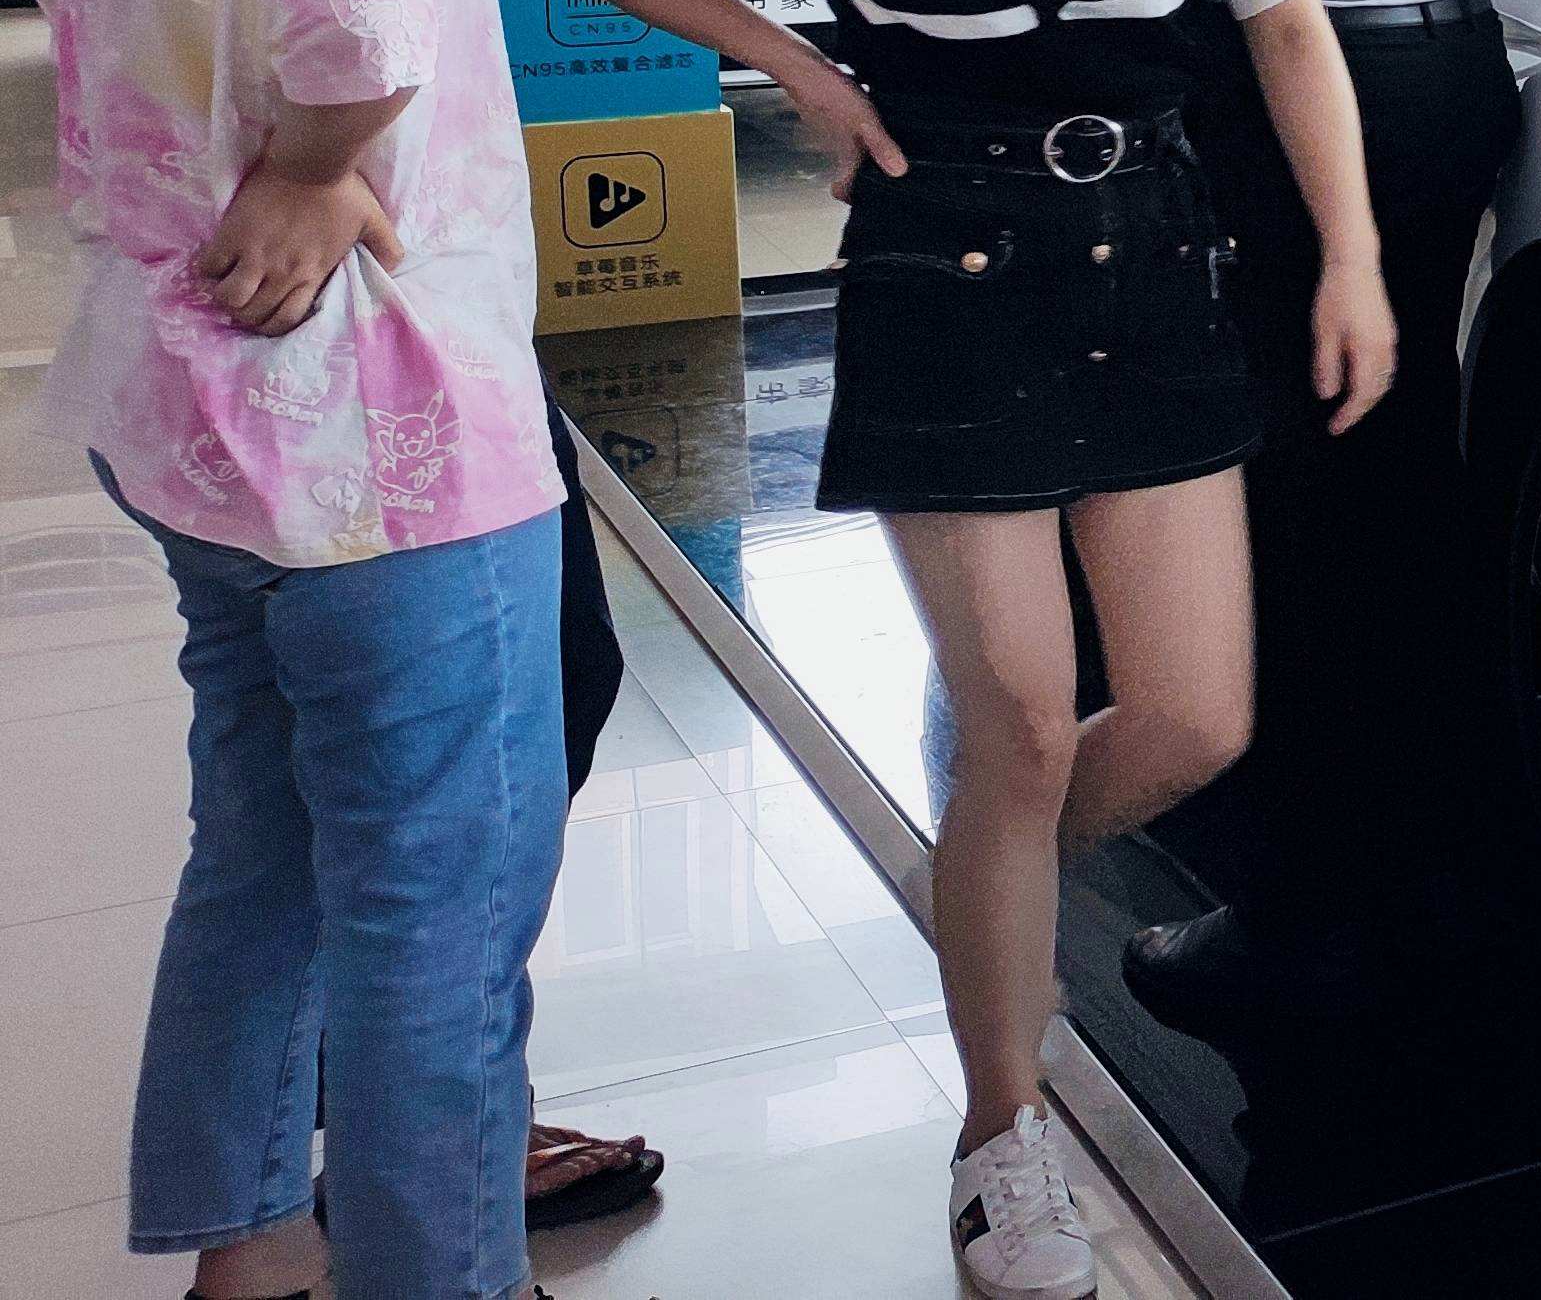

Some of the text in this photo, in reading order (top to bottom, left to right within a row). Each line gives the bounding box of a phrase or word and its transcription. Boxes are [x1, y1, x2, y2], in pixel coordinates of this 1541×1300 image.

[569, 21, 632, 36] CN95
[510, 51, 695, 80] CN95高效复合滤芯
